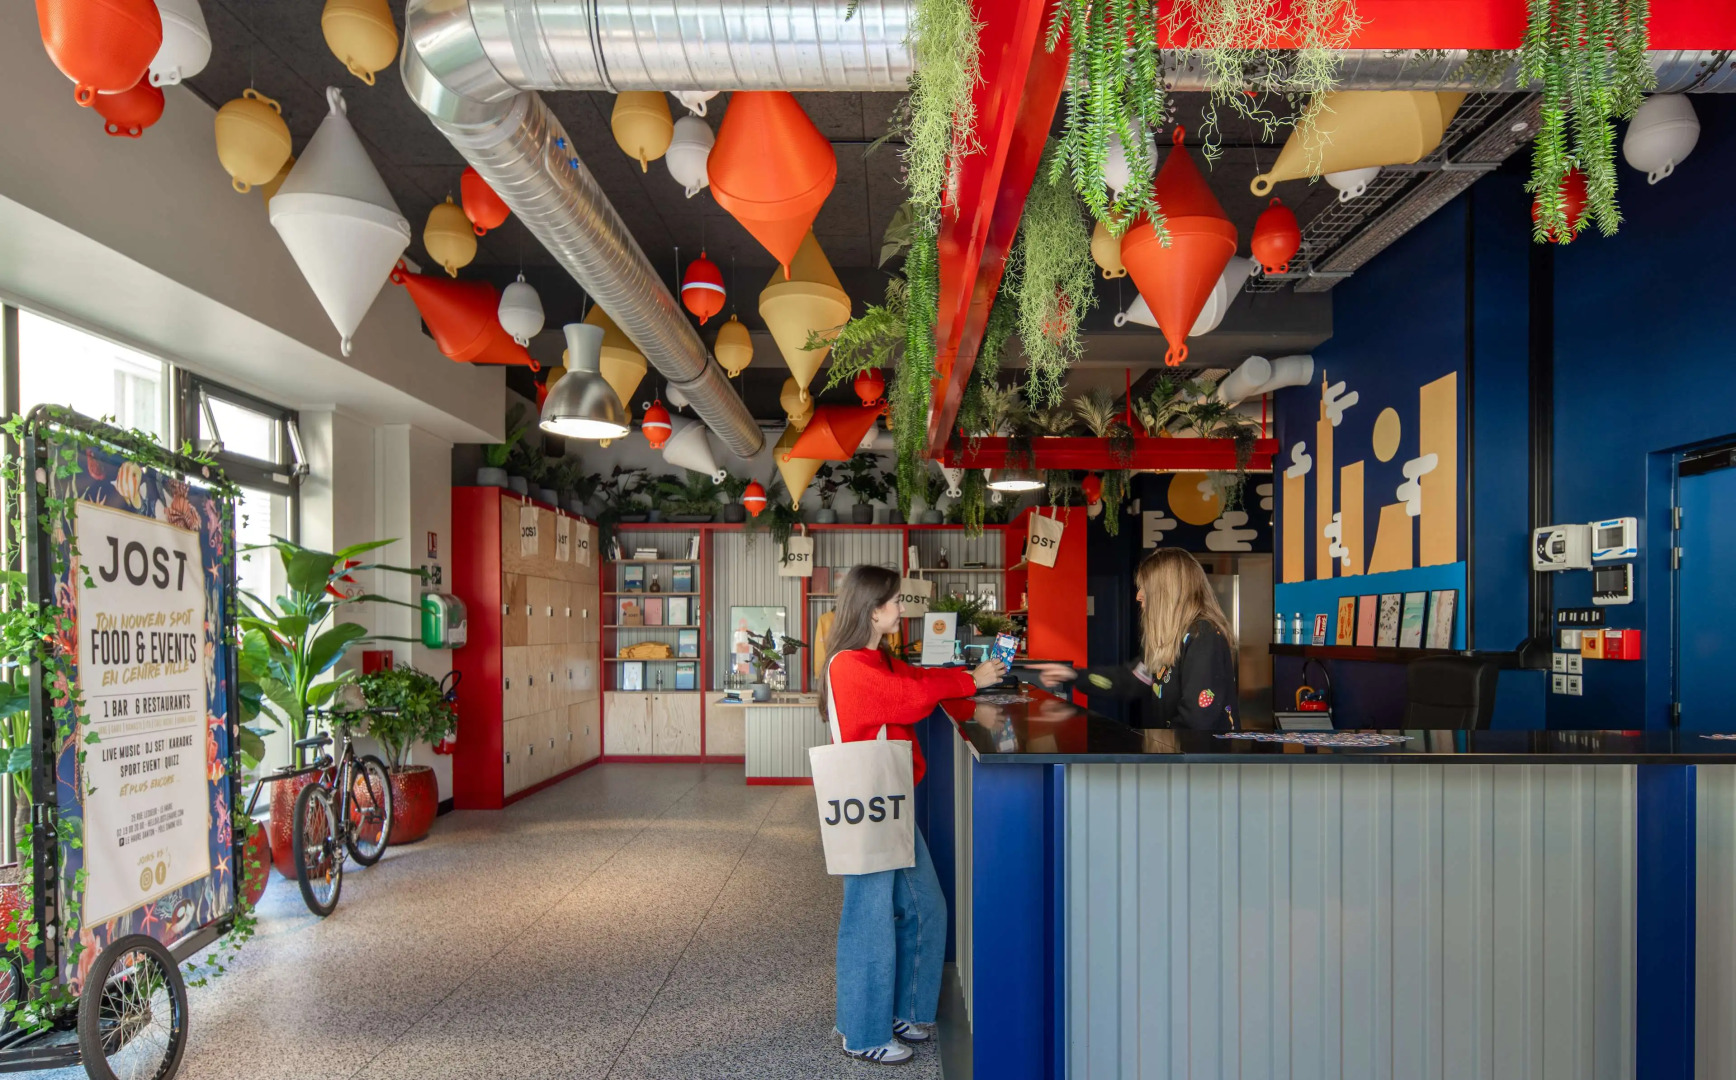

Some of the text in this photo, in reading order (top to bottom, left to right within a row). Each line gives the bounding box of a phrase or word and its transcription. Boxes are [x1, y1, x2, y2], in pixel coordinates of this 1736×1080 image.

[577, 539, 588, 549] JO
[1031, 535, 1056, 549] OST
[99, 536, 187, 591] JOST
[788, 553, 810, 562] OST
[899, 594, 927, 604] JOST
[96, 608, 194, 631] TON NOUVEAU SPOT
[91, 629, 196, 665] FOOD & EVENTS
[102, 659, 190, 687] EN CENTRE VILLE
[104, 694, 191, 718] 1 BAR 6 RESTAURANTS
[102, 735, 192, 762] LIVE MUSIC DJ SET KARAOKE
[120, 754, 179, 777] SPORT EVENT QUIZZ
[120, 783, 129, 797] ET
[129, 781, 148, 795] PLUS
[825, 795, 906, 826] JOST
